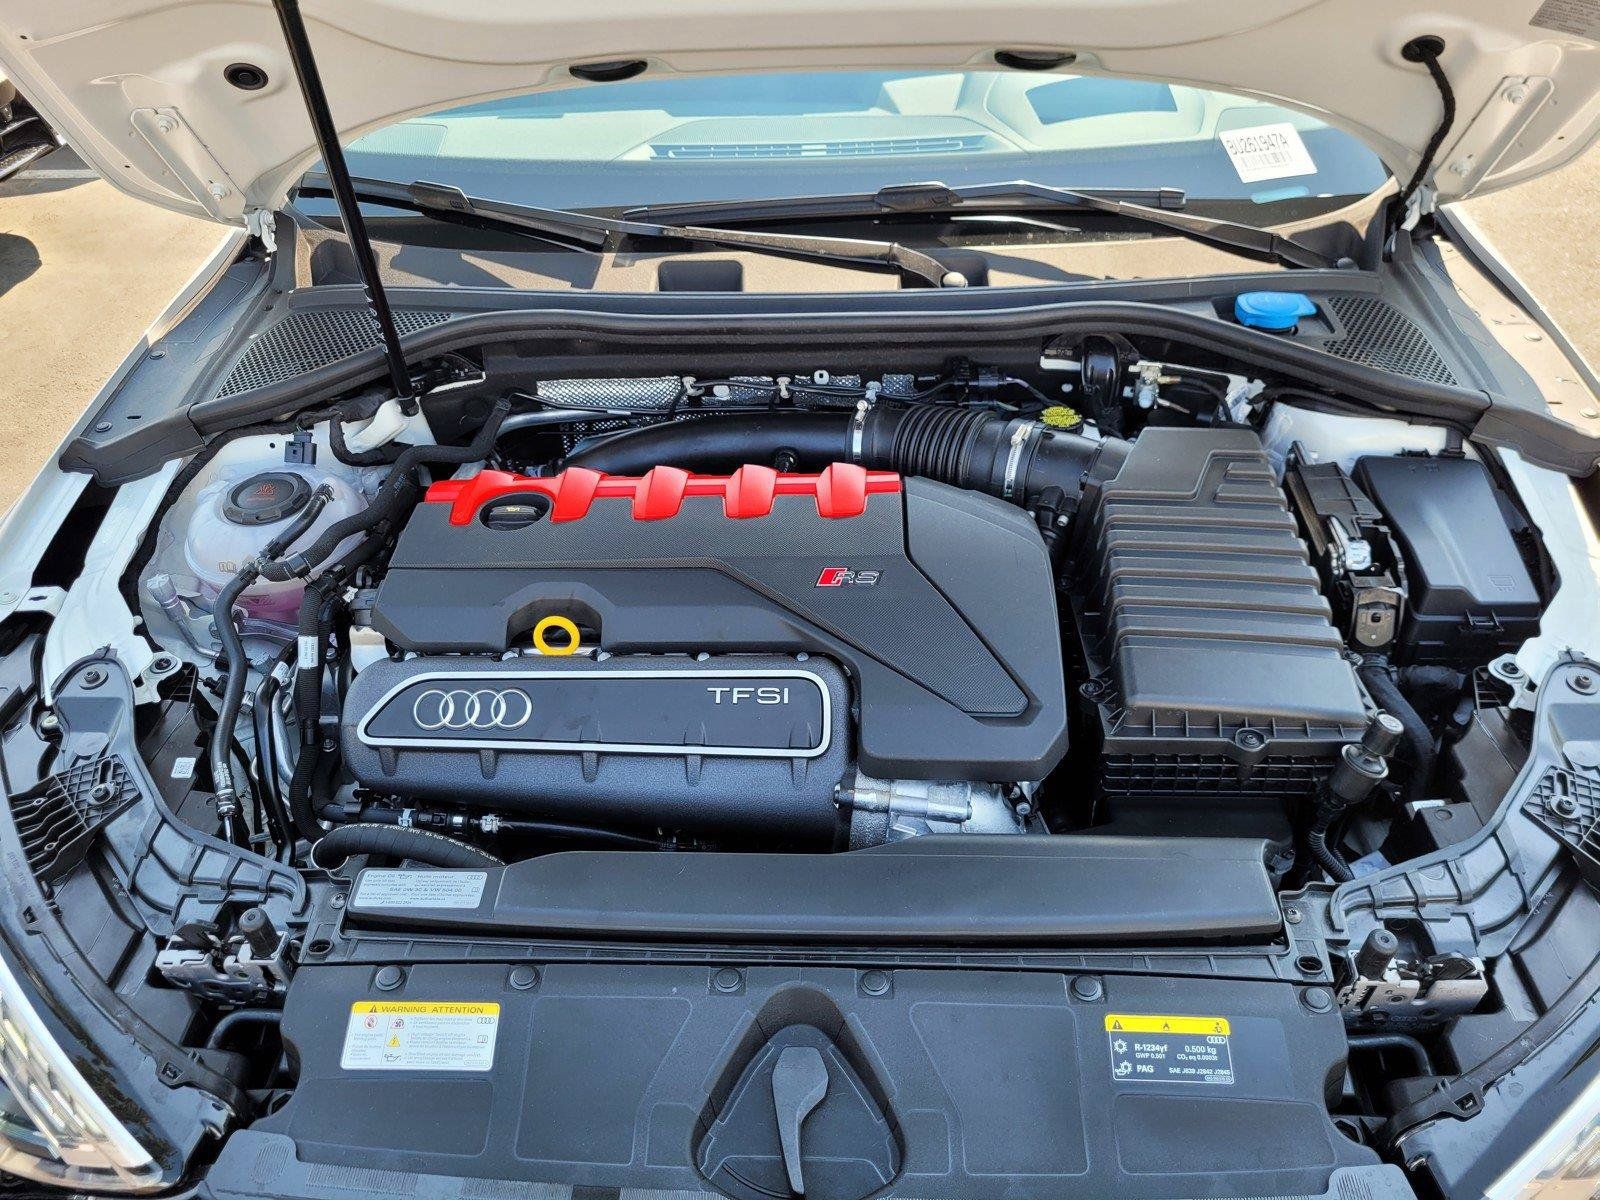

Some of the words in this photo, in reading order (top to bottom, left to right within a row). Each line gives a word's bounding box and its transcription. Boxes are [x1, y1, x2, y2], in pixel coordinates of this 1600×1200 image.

[830, 570, 880, 585] RS
[707, 687, 789, 704] TFSI
[381, 1005, 427, 1013] WARNING
[431, 1005, 484, 1014] ATTENTION
[1134, 1043, 1168, 1053] R-1234yf
[1184, 1045, 1206, 1053] 0.500
[1207, 1045, 1217, 1055] kg
[1136, 1064, 1154, 1073] PAG
